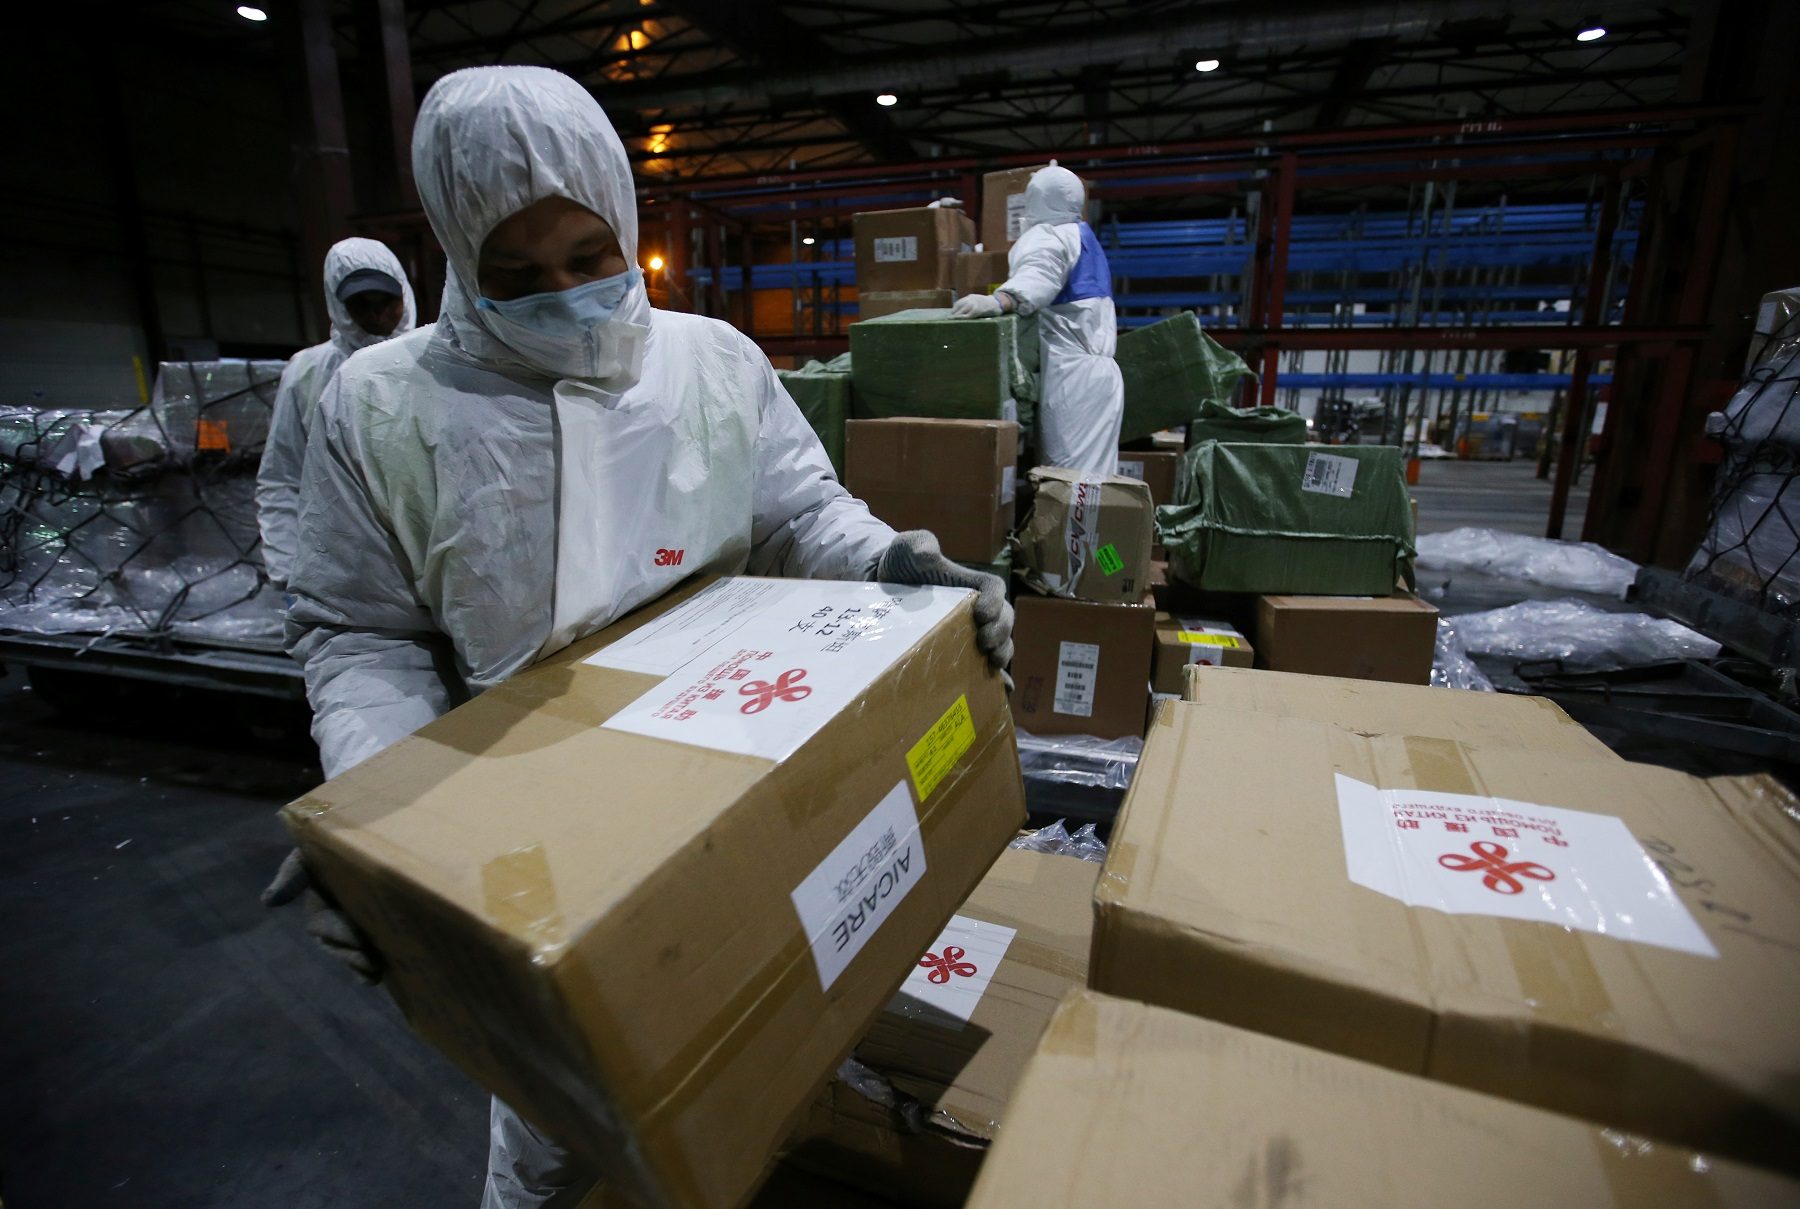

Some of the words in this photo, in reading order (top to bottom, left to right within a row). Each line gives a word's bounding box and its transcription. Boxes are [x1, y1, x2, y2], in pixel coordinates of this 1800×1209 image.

[654, 548, 684, 566] 3M
[811, 605, 833, 618] 40
[710, 650, 760, 681] ПОМОЩЬ
[696, 682, 716, 692] ИЗ
[660, 694, 700, 719] КИТАЯ
[1393, 809, 1448, 820] КИТАЯ
[1455, 813, 1476, 823] ИЗ
[1480, 815, 1562, 837] ПОМОЩЬ
[832, 846, 911, 953] AICARE
